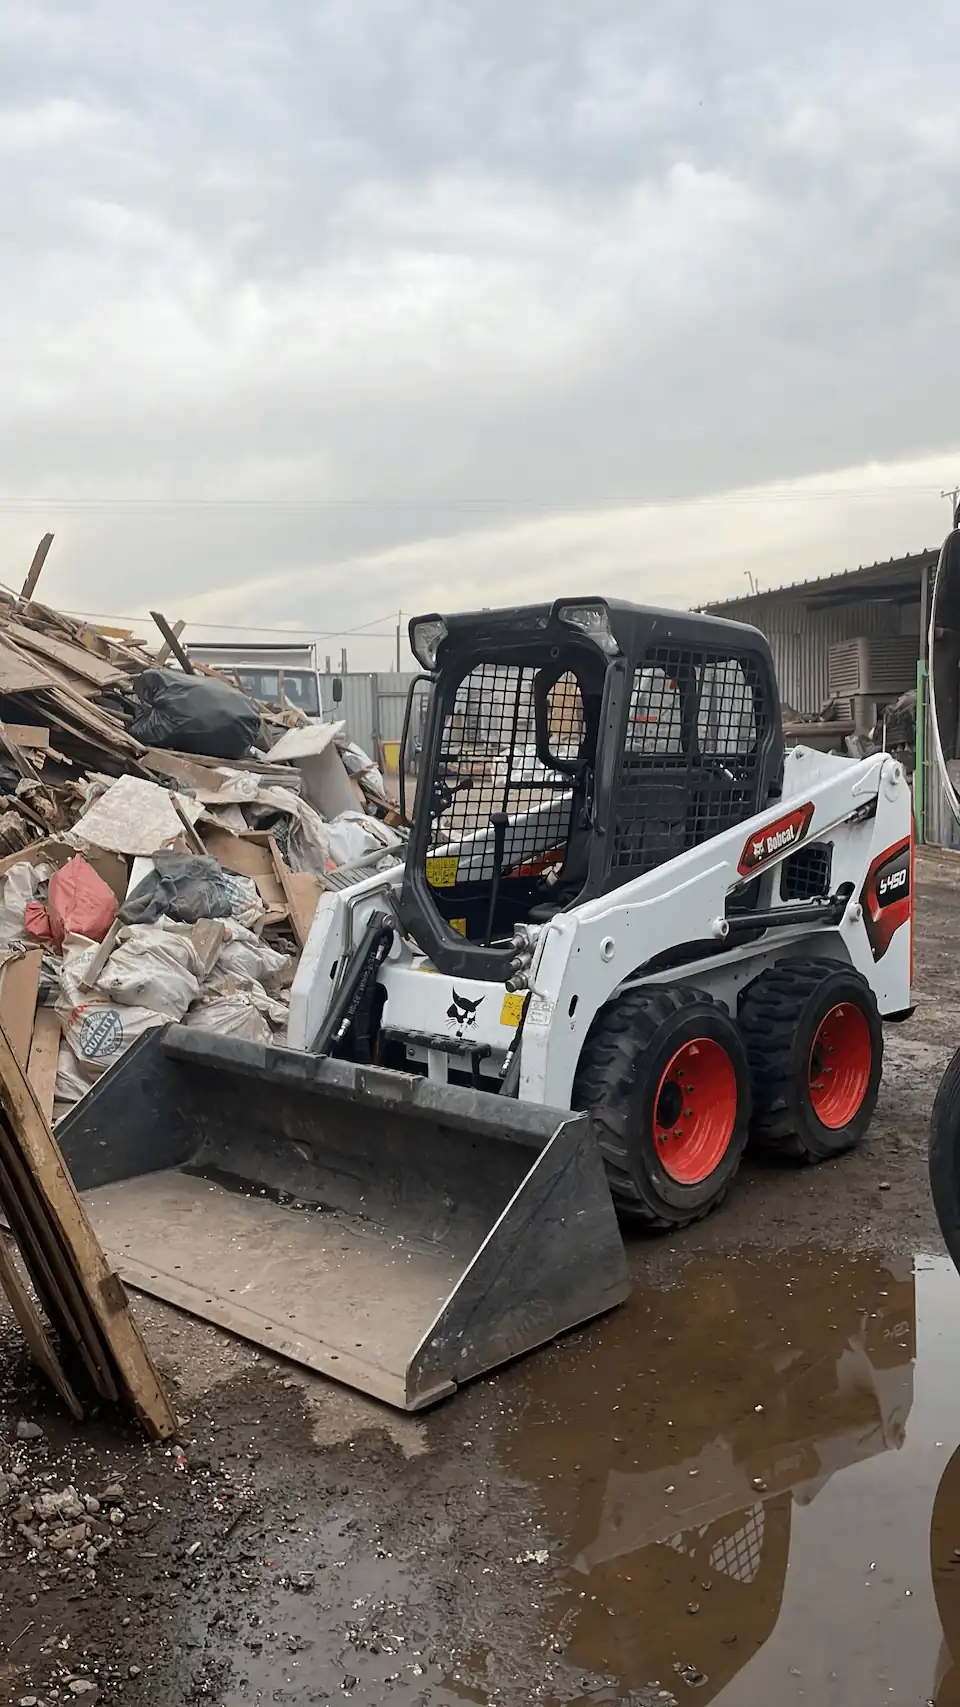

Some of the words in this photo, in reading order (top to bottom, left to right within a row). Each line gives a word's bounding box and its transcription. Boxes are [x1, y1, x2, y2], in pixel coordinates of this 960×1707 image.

[766, 824, 795, 853] Bobcat
[879, 868, 907, 895] S450
[84, 1012, 115, 1055] QUALITY
